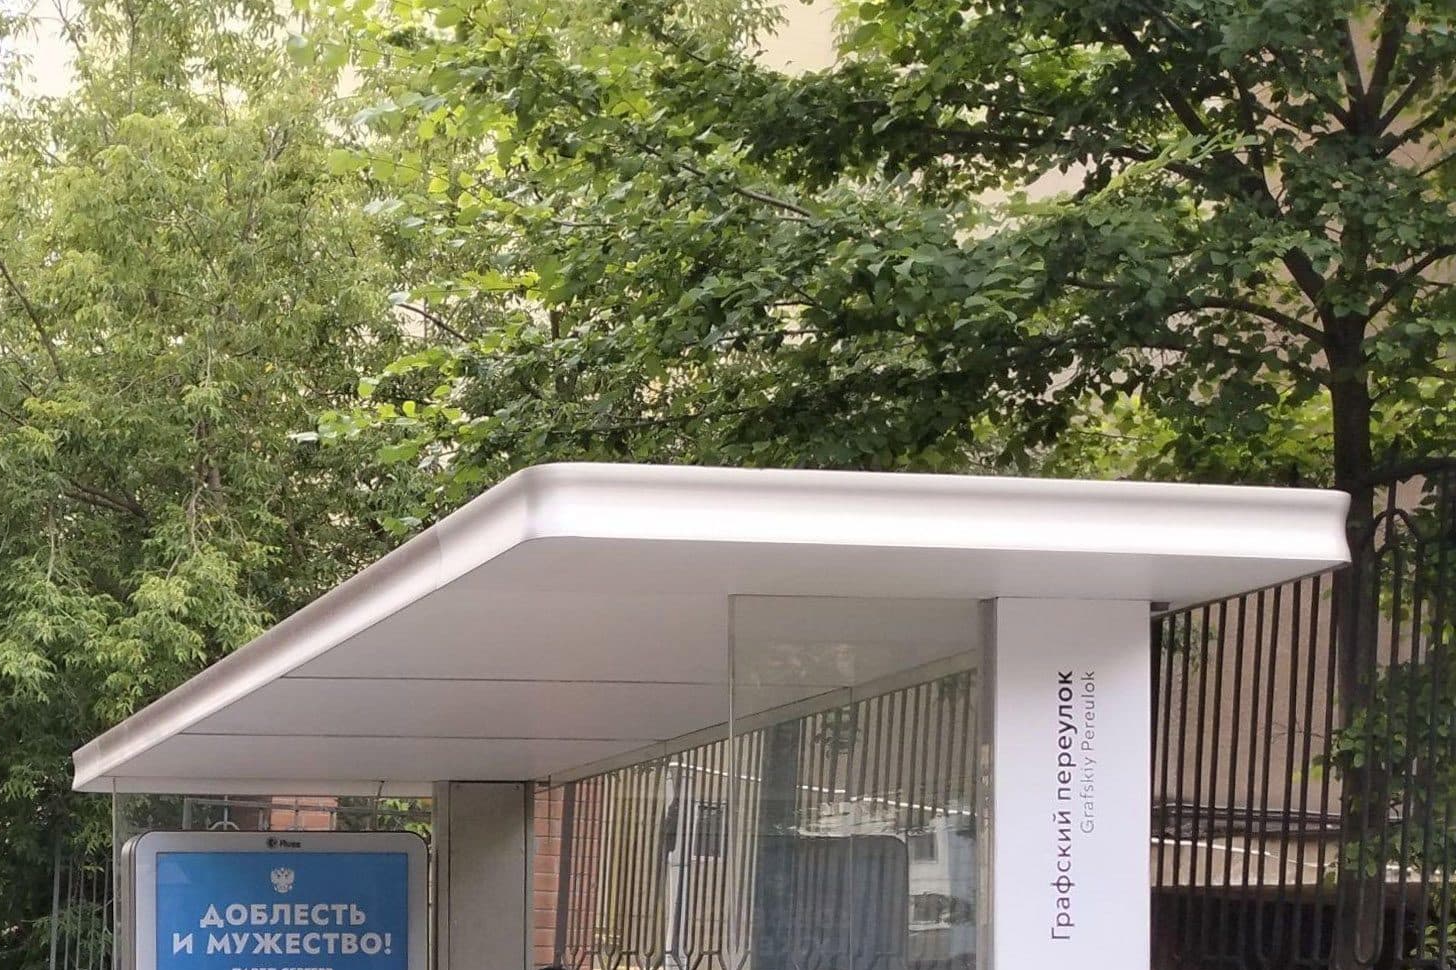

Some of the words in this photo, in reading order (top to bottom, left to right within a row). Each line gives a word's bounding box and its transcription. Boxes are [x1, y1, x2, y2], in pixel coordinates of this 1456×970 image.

[1057, 670, 1078, 801] переулок
[1081, 670, 1095, 751] Pereulok
[1080, 757, 1097, 834] Grafskiy
[1050, 811, 1075, 940] Графский
[172, 932, 193, 954] И
[206, 932, 392, 955] МУЖЕСТВО!
[199, 903, 367, 928] ДОБЛЕСТЬ
